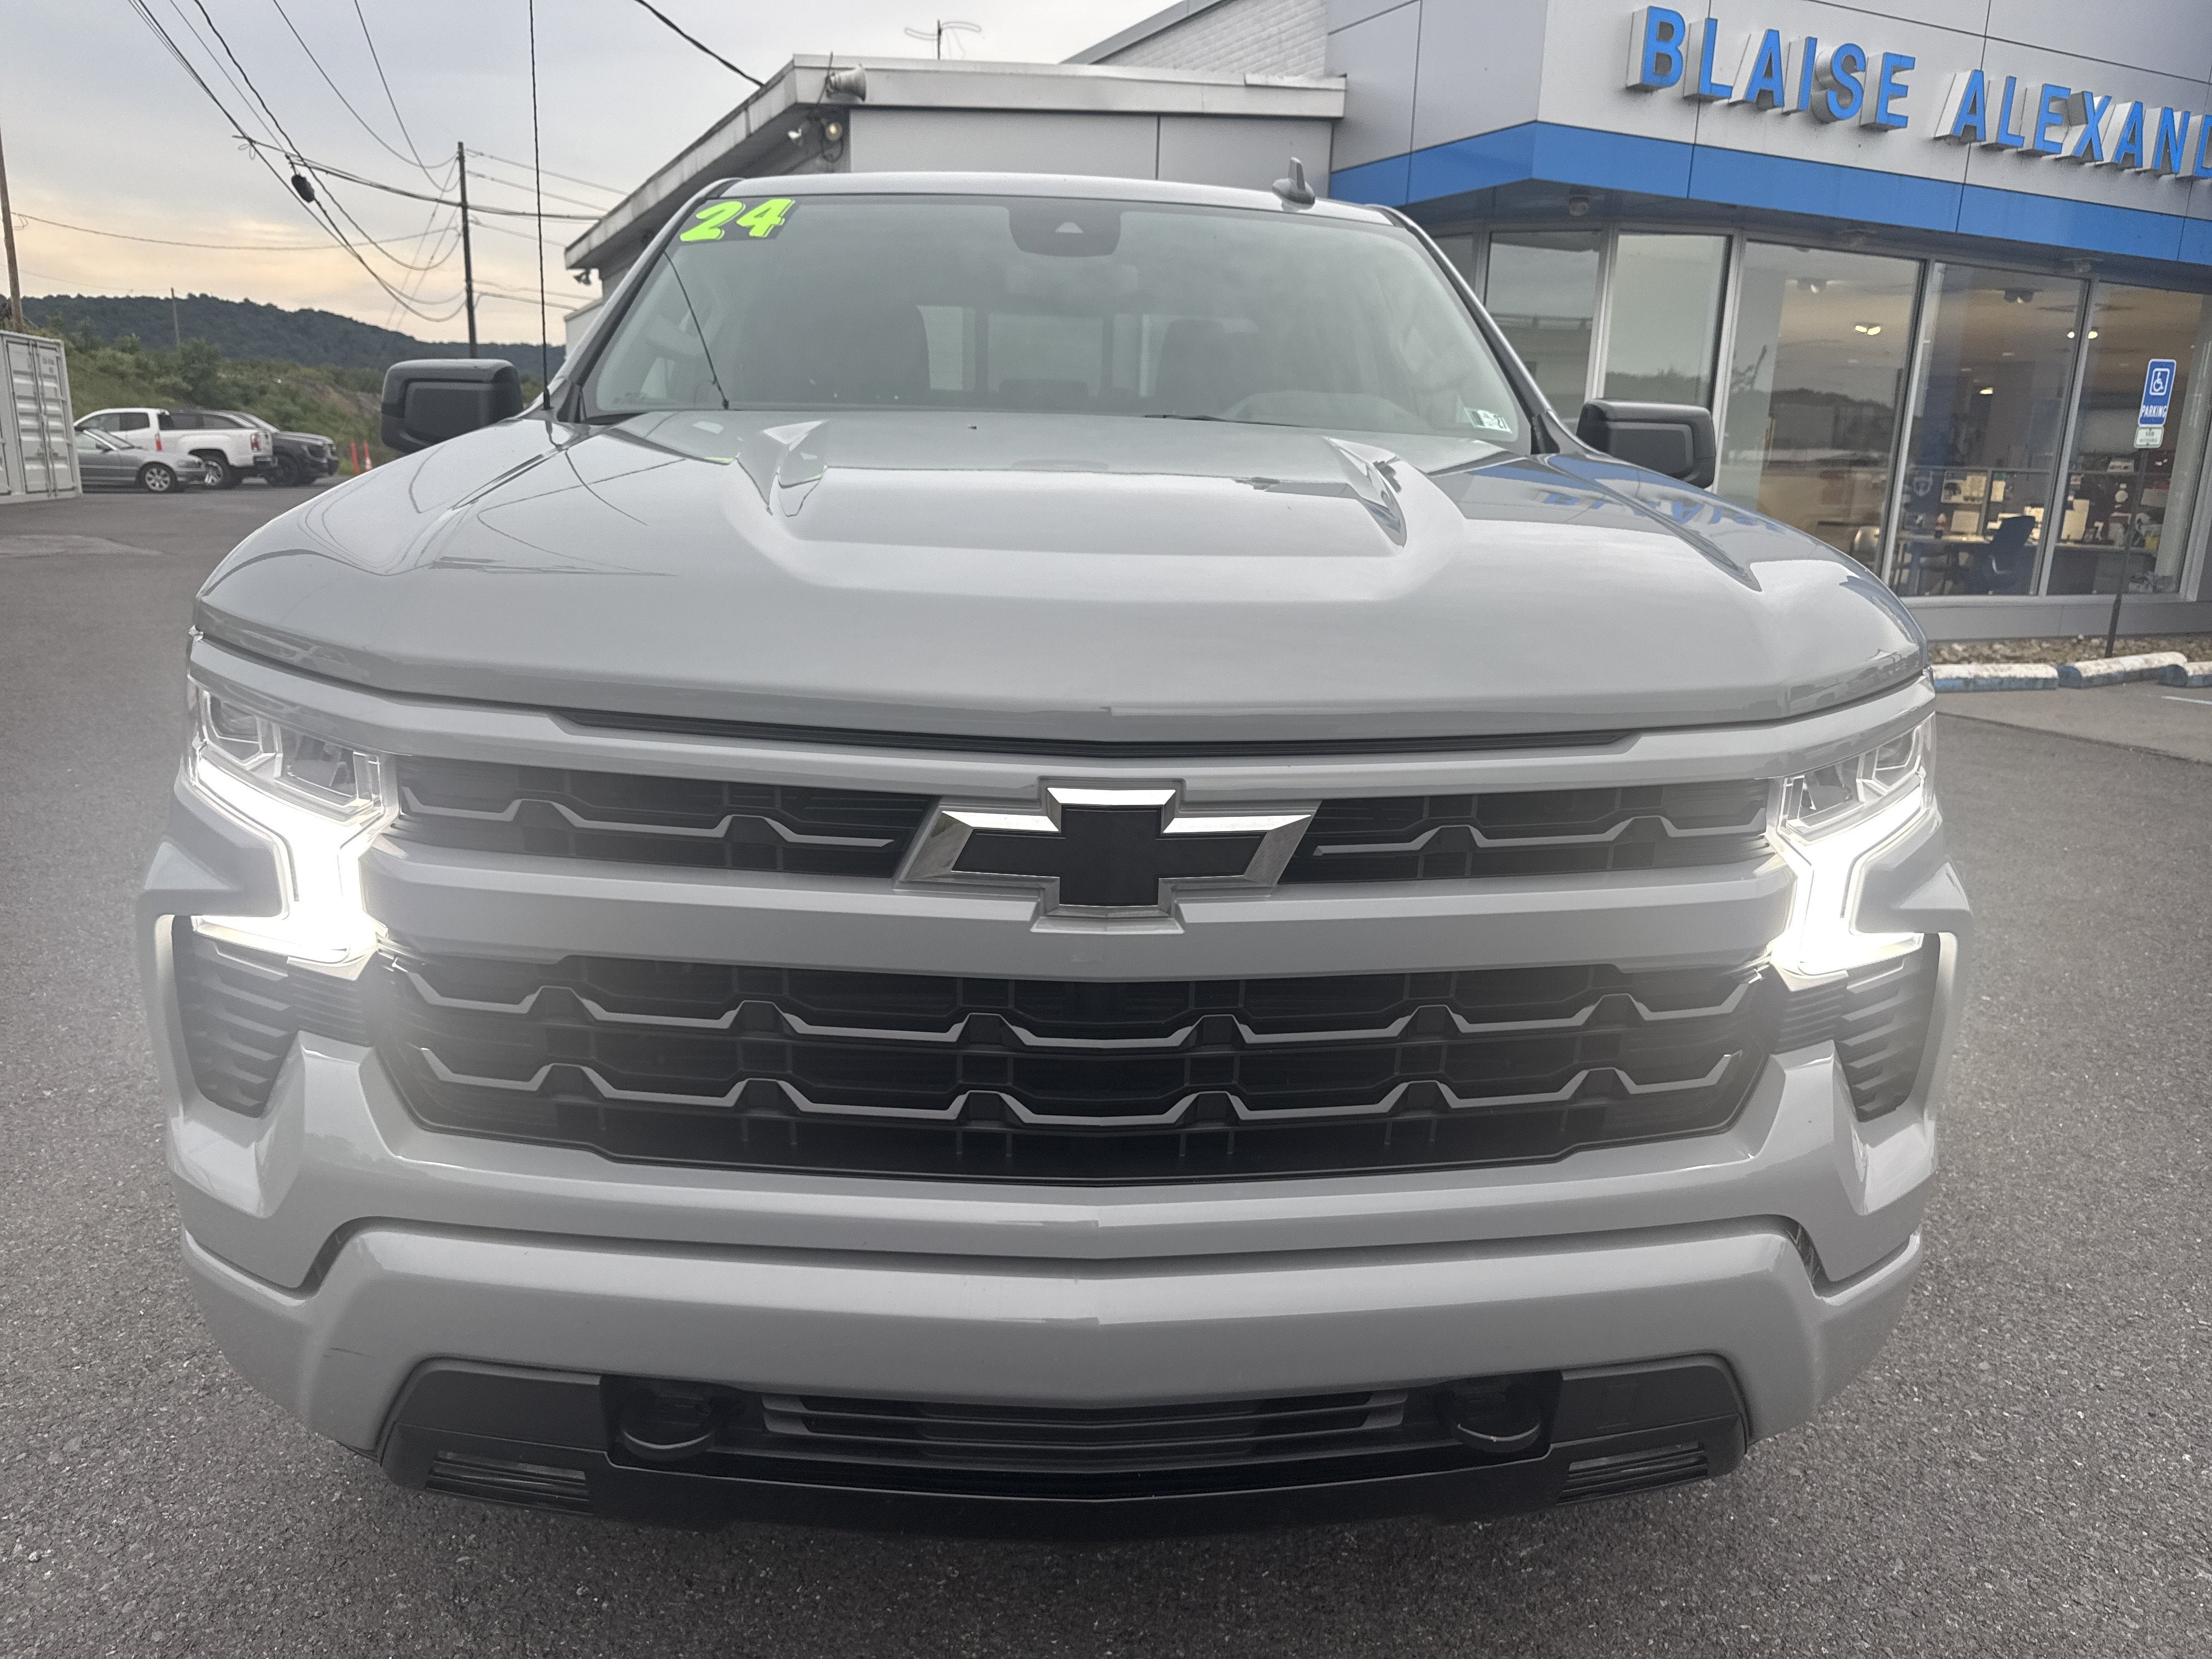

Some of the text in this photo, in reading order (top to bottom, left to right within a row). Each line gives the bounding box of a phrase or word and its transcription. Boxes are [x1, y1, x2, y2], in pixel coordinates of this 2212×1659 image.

[1642, 6, 1915, 129] BLAISE
[680, 198, 795, 241] 24
[2140, 405, 2168, 417] PARKING
